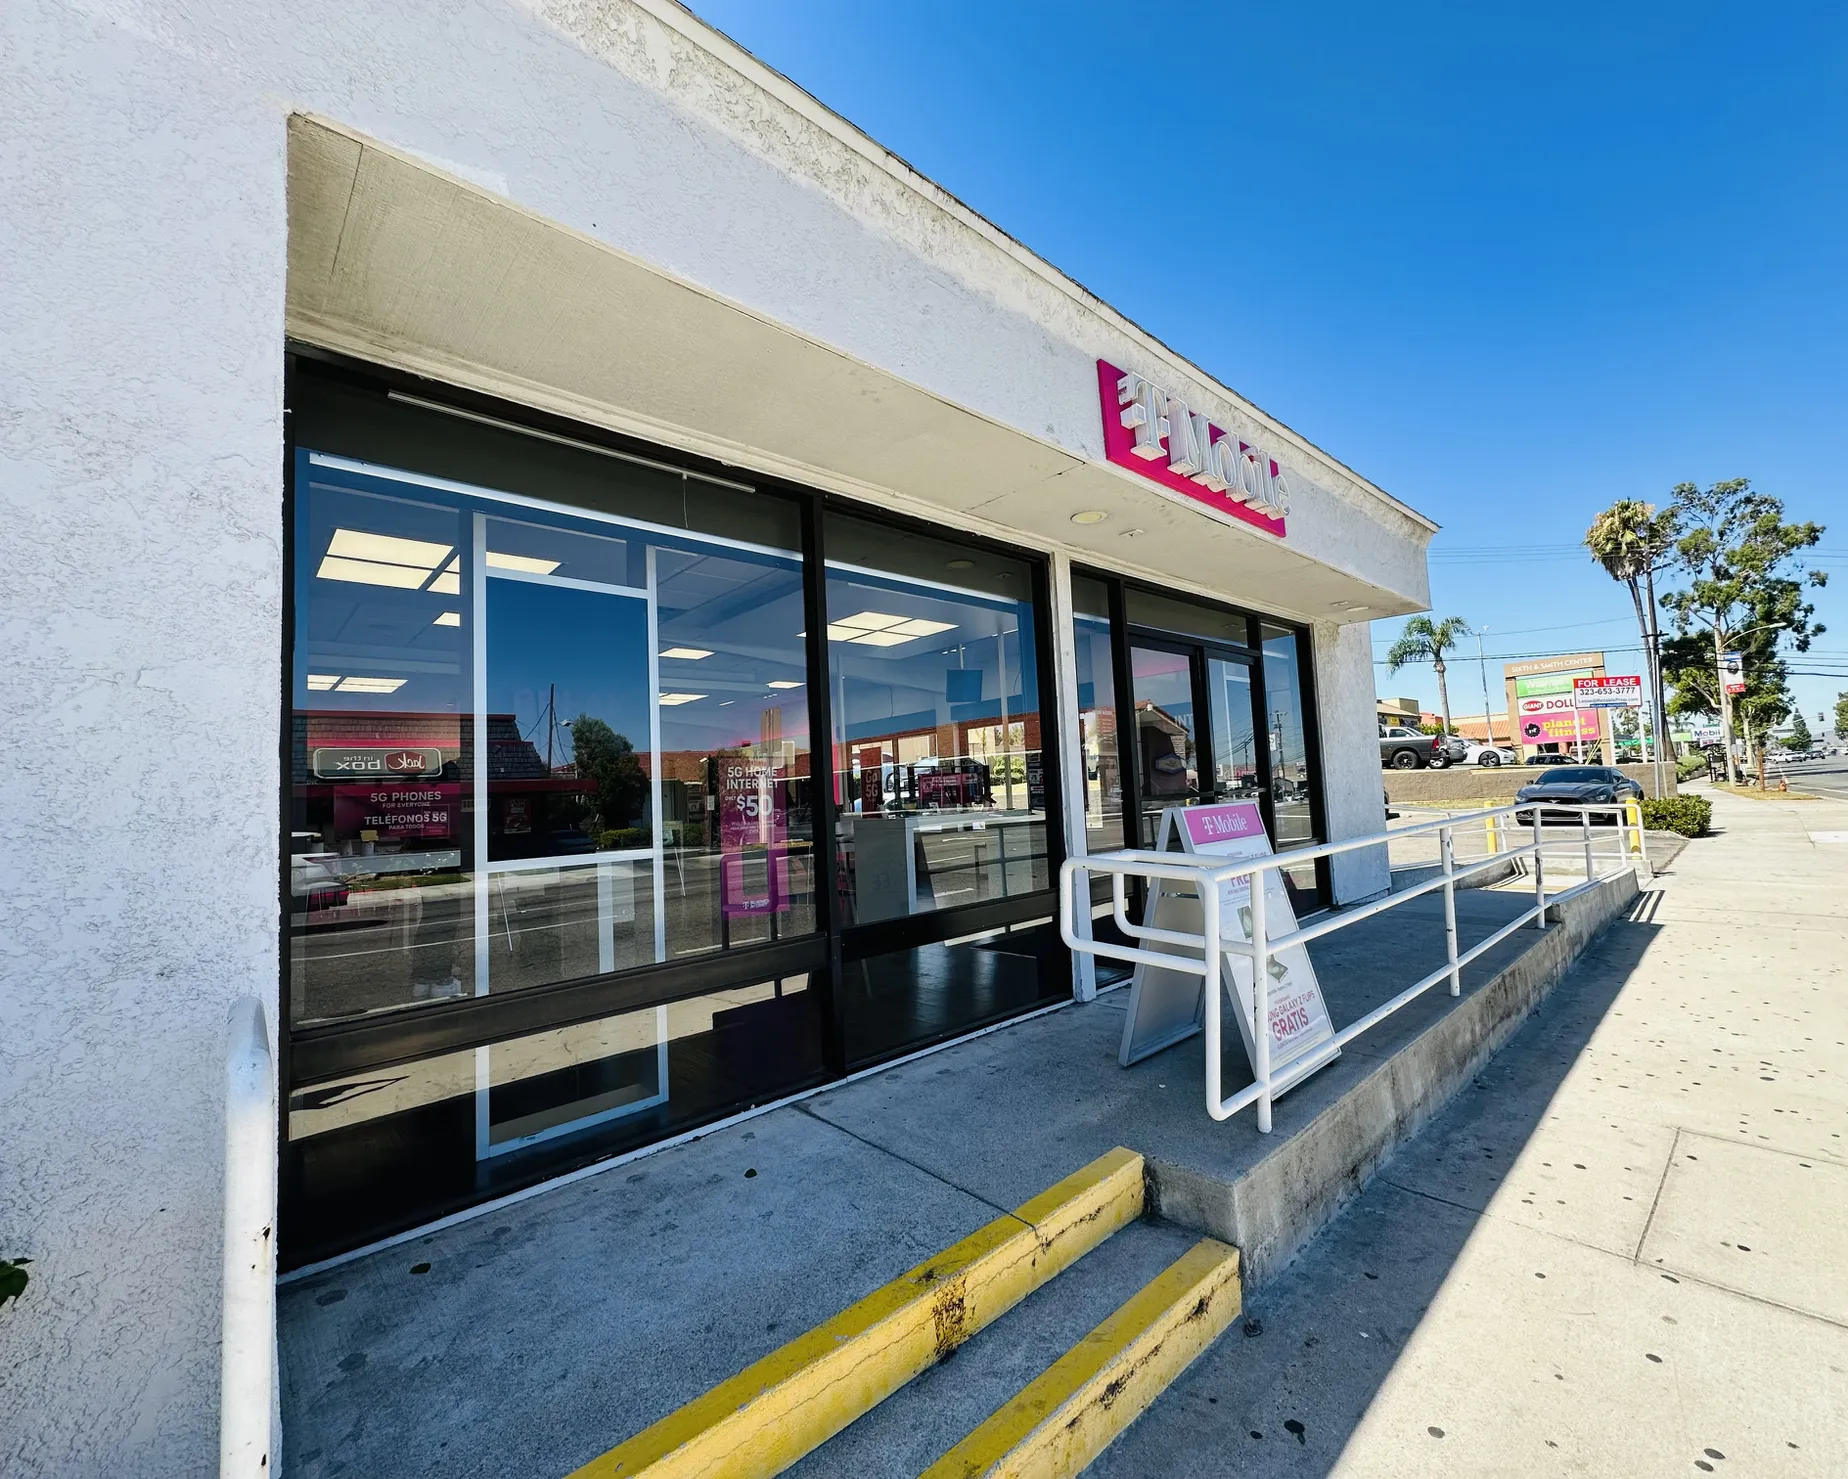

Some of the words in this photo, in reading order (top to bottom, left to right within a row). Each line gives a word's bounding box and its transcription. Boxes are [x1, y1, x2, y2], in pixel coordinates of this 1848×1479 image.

[1511, 665, 1532, 673] SIXTH
[1540, 661, 1563, 669] SMITH
[1564, 657, 1593, 666] CENTER
[1577, 680, 1599, 688] FOR
[1603, 678, 1637, 687] LEASE
[1579, 687, 1636, 696] 323-653-3777
[1542, 717, 1586, 731] plant
[727, 766, 743, 778] 5G
[745, 766, 778, 777] HOME
[726, 778, 778, 790] INTERNET
[866, 784, 879, 798] 5G
[370, 793, 388, 802] 5G
[392, 791, 442, 802] PHONES
[736, 793, 773, 817] $50
[364, 813, 430, 826] TELÉFONOS
[431, 812, 448, 823] 5G
[1230, 873, 1251, 888] FRE
[1278, 997, 1299, 1015] GALAXY
[1272, 1007, 1309, 1041] GRATIS
